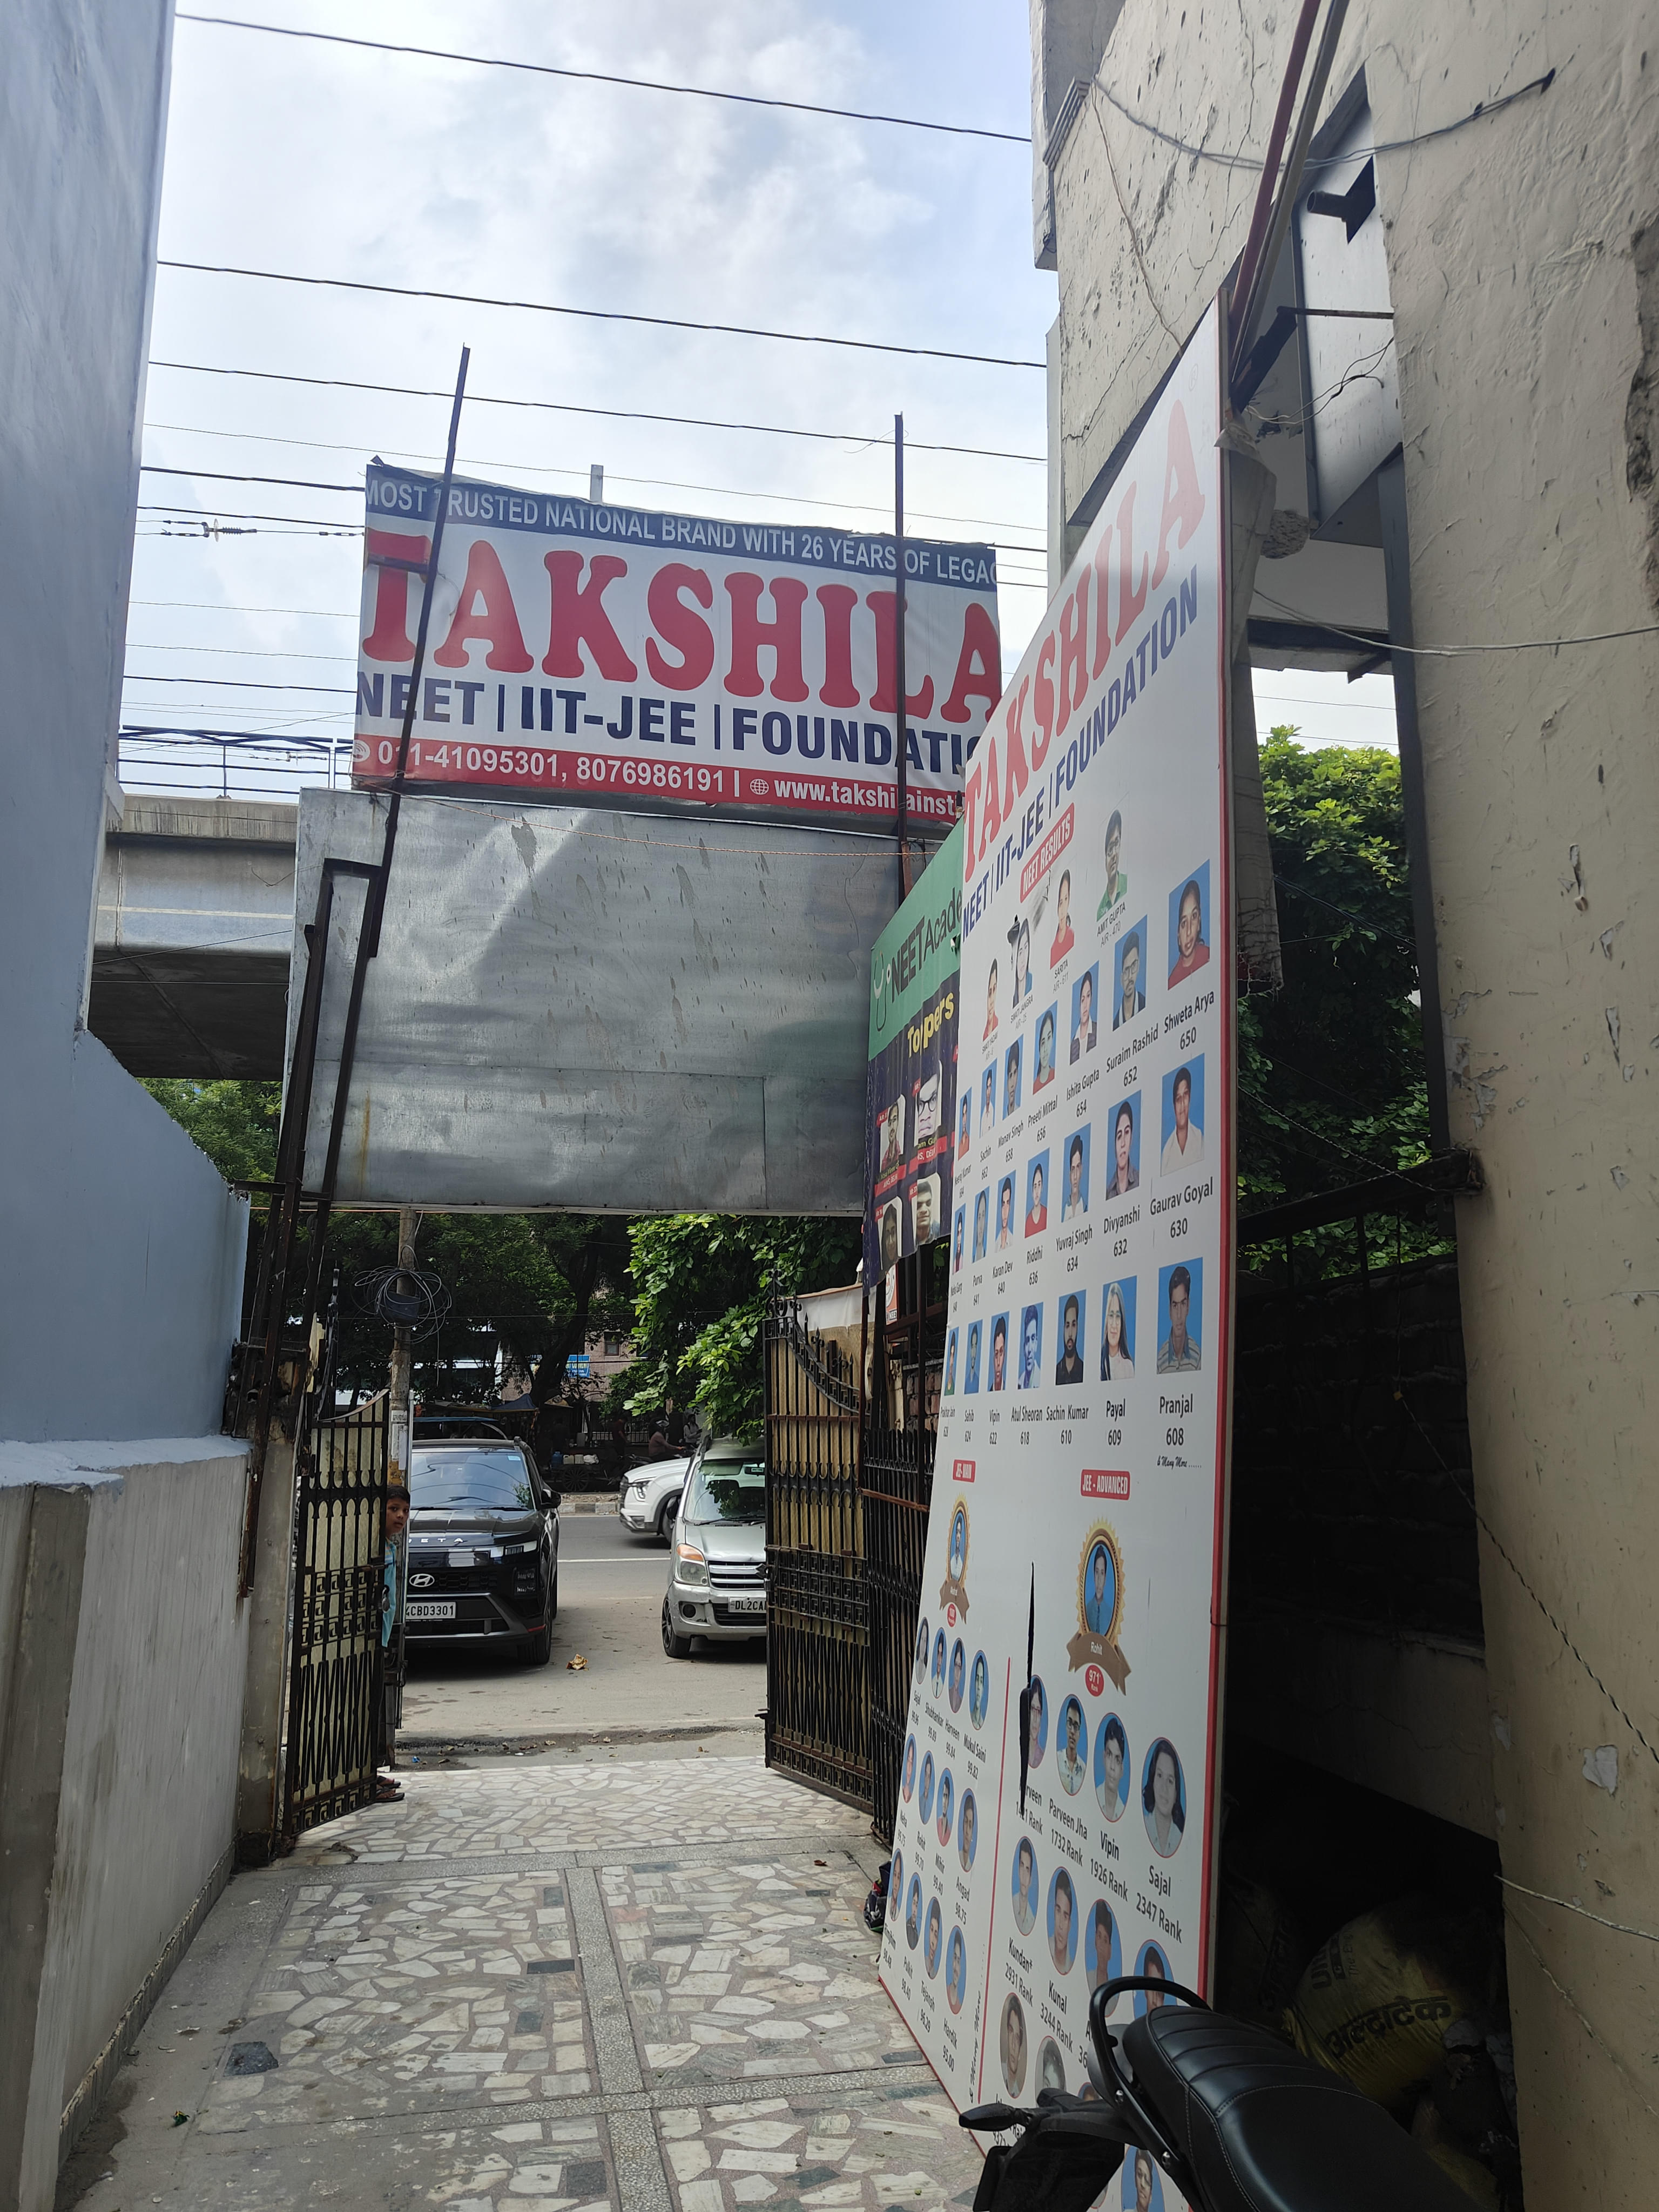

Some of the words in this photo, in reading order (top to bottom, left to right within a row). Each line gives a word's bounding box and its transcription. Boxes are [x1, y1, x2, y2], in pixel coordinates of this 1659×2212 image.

[366, 480, 427, 512] MOST
[545, 502, 656, 540] NATIONAL
[662, 515, 736, 549] BRAND
[743, 527, 795, 557] WITH
[801, 534, 824, 561] 26
[828, 538, 897, 571] YEARS
[904, 549, 929, 576] OF
[362, 528, 1002, 724] TAKSHILA
[964, 398, 1205, 882] TAKSHILA
[356, 671, 484, 725] NEET
[521, 686, 696, 746] IIT-JEE
[963, 870, 989, 943] NEET
[996, 790, 1044, 893] IIT-JEE
[1055, 563, 1197, 809] FOUNDATION
[577, 759, 724, 793] 8076986191
[1023, 854, 1039, 895] NEET
[1040, 812, 1070, 873] RESULTS
[1109, 901, 1125, 925] GUPTA
[1164, 1003, 1192, 1034] Shweta
[1194, 991, 1215, 1014] Arya
[1107, 1047, 1131, 1073] Suraim
[1132, 1023, 1158, 1056] Rashid
[1180, 1027, 1197, 1050] 650
[1066, 1081, 1081, 1101] Ishita
[1082, 1068, 1100, 1091] Gupta
[1123, 1066, 1137, 1087] 652
[1028, 1108, 1042, 1128] Preeti
[1042, 1095, 1058, 1120] Mittal
[1076, 1098, 1087, 1117] 654
[998, 1131, 1011, 1149] Manav
[1011, 1120, 1023, 1138] Singh
[1036, 1125, 1046, 1143] 656
[1150, 1191, 1182, 1215] Gaurav
[1183, 1176, 1213, 1204] Goyal
[1103, 1204, 1141, 1234] Divyanshi
[1170, 1217, 1188, 1238] 630
[1056, 1231, 1074, 1252] Yuvraj
[1074, 1224, 1092, 1245] Singh
[1114, 1238, 1127, 1257] 632
[1026, 1245, 1043, 1265] Riddhi
[1067, 1256, 1078, 1272] 634
[973, 1274, 982, 1287] Purva
[993, 1264, 1004, 1279] Karan
[1004, 1261, 1013, 1275] Dev
[1029, 1271, 1038, 1285] 636
[989, 1408, 1000, 1426] Vipin
[1011, 1405, 1021, 1422] Atul
[1021, 1404, 1043, 1422] Sheoran
[1046, 1404, 1065, 1421] Sachin
[1068, 1404, 1089, 1420] Kumar
[1106, 1398, 1125, 1421] Payal
[1159, 1393, 1193, 1418] Pranjal
[989, 1432, 997, 1445] 622
[1020, 1432, 1030, 1445] 618
[1061, 1429, 1072, 1445] 610
[1108, 1429, 1122, 1446] 609
[1166, 1427, 1184, 1446] 608
[1082, 1474, 1091, 1492] JEE
[1097, 1475, 1128, 1495] ADVANCED
[406, 1605, 453, 1616] 4CBD3301
[945, 1718, 960, 1741] Harveen
[963, 1734, 976, 1755] Mukul
[976, 1742, 986, 1763] Saini
[1029, 1810, 1043, 1835] Rank
[1049, 1798, 1075, 1831] Parveen
[1076, 1816, 1088, 1840] Jha
[1051, 1828, 1065, 1852] 1732
[1067, 1838, 1083, 1867] Rank
[1100, 1830, 1120, 1861] Vipin
[956, 1876, 970, 1902] Angad
[1090, 1858, 1108, 1885] 1926
[1109, 1871, 1128, 1902] Rank
[1149, 1865, 1171, 1897] Sajal
[955, 1901, 967, 1925] 98.75
[1136, 1892, 1157, 1923] 2347
[1159, 1908, 1182, 1944] Rank
[921, 1980, 935, 2012] Tejansh
[1004, 1963, 1018, 1991] 2931
[1019, 1976, 1033, 2007] Rank
[1048, 1980, 1068, 2015] Kunal
[943, 2017, 957, 2051] Hardik
[1040, 2002, 1056, 2033] 3244
[1057, 2022, 1073, 2053] Rank
[942, 2045, 954, 2073] 95.00
